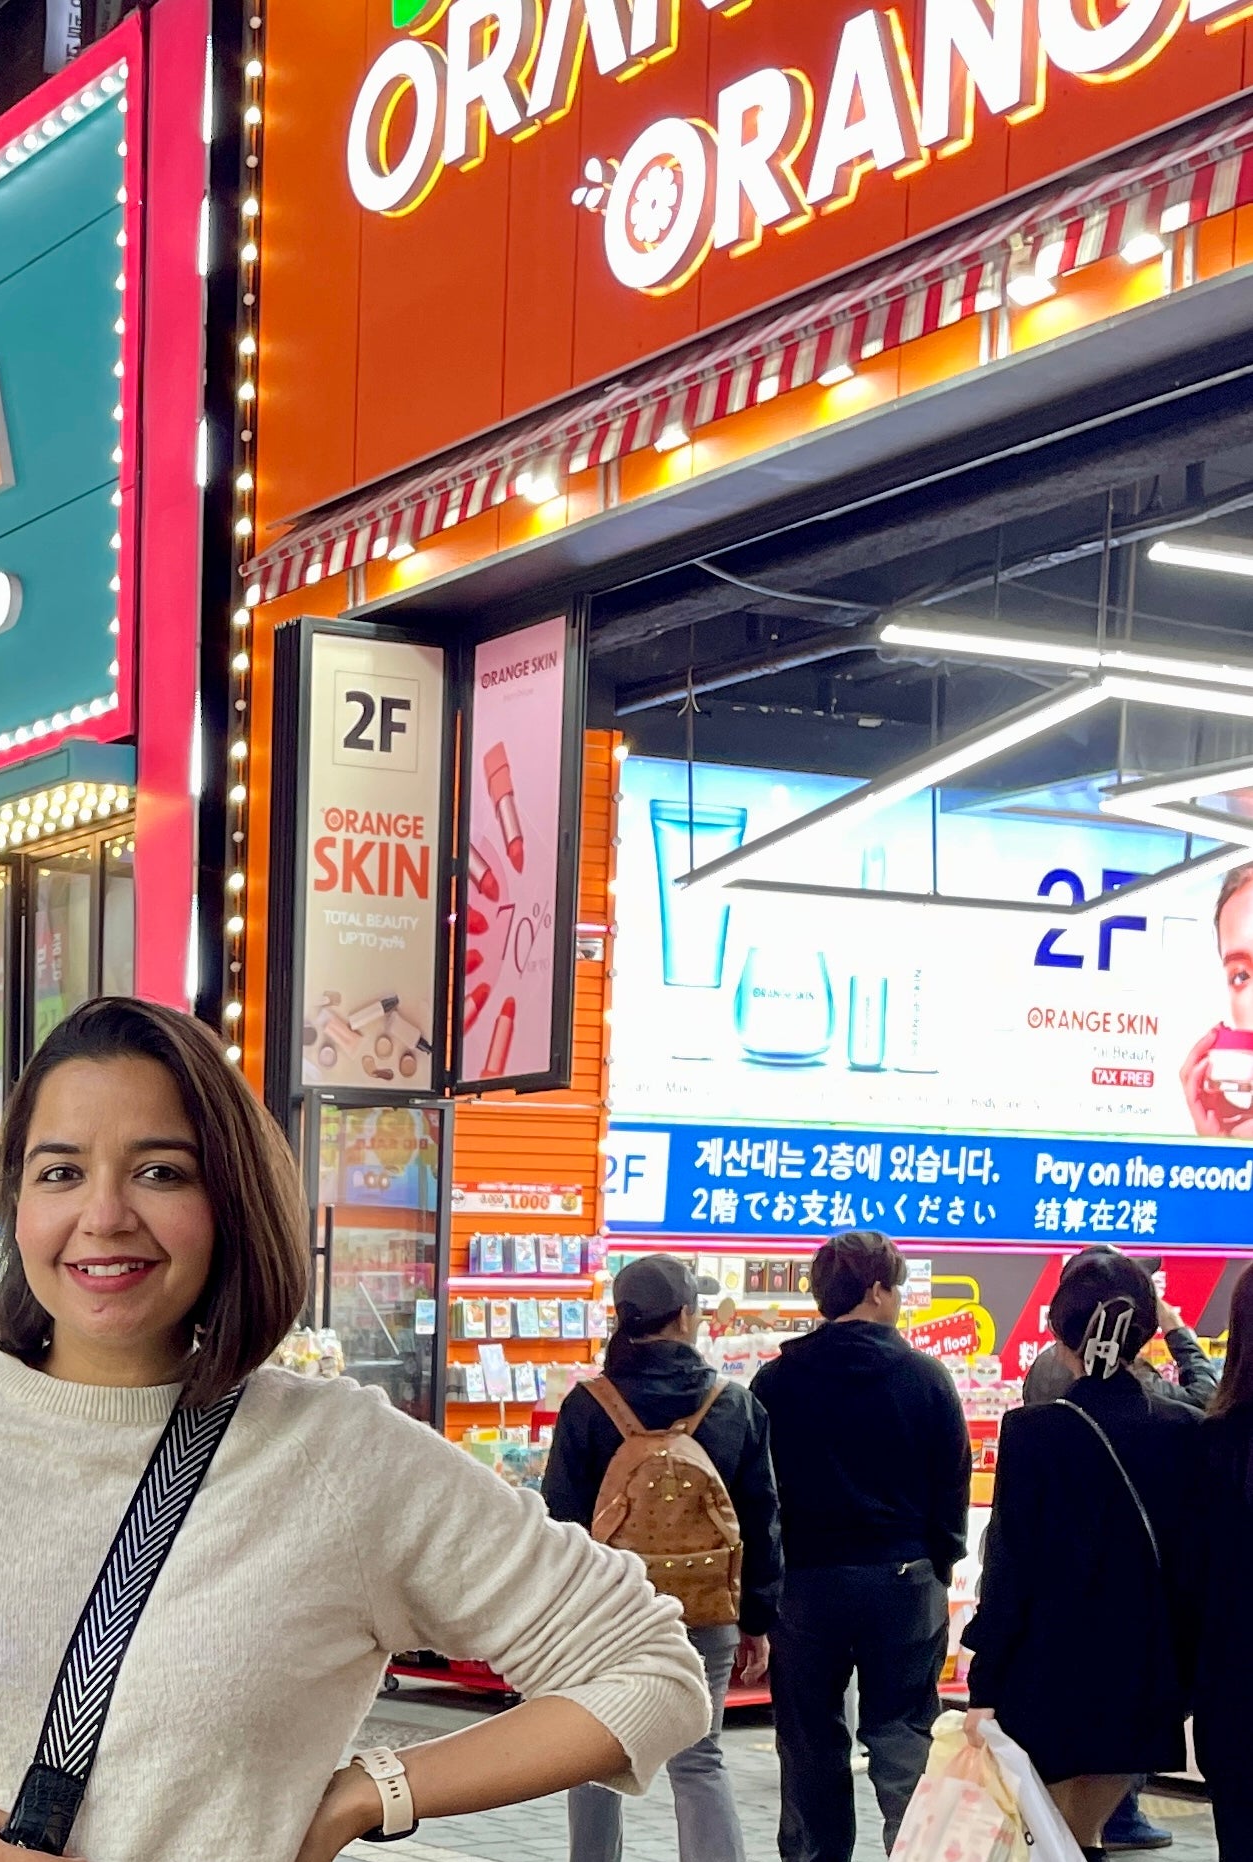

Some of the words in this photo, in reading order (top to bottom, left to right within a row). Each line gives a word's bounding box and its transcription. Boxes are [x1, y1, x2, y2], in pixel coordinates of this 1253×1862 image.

[604, 0, 1253, 291] ORAN
[481, 660, 530, 689] ORANGE
[531, 650, 558, 673] SKIN
[343, 690, 412, 752] 2F
[324, 807, 425, 839] ORANGE
[314, 836, 430, 900] SKIN
[323, 909, 363, 928] TOTAL
[366, 912, 421, 931] BEAUTY
[1027, 1007, 1112, 1032] ORANGE
[1116, 1013, 1158, 1035] SKIN
[1094, 1069, 1118, 1085] TAX
[1119, 1071, 1152, 1087] FREE
[604, 1154, 646, 1194] 2F
[695, 1138, 805, 1179] 계산대는
[810, 1143, 882, 1182] 2층에
[889, 1144, 1000, 1185] 있습니다.
[1035, 1152, 1085, 1192] Pay
[1088, 1161, 1120, 1187] on
[1125, 1155, 1165, 1188] the
[1168, 1159, 1252, 1192] second
[691, 1187, 997, 1227] 2階でお支払いください
[1034, 1196, 1158, 1235] 结算在2楼
[914, 1334, 931, 1346] the
[943, 1334, 972, 1352] floor
